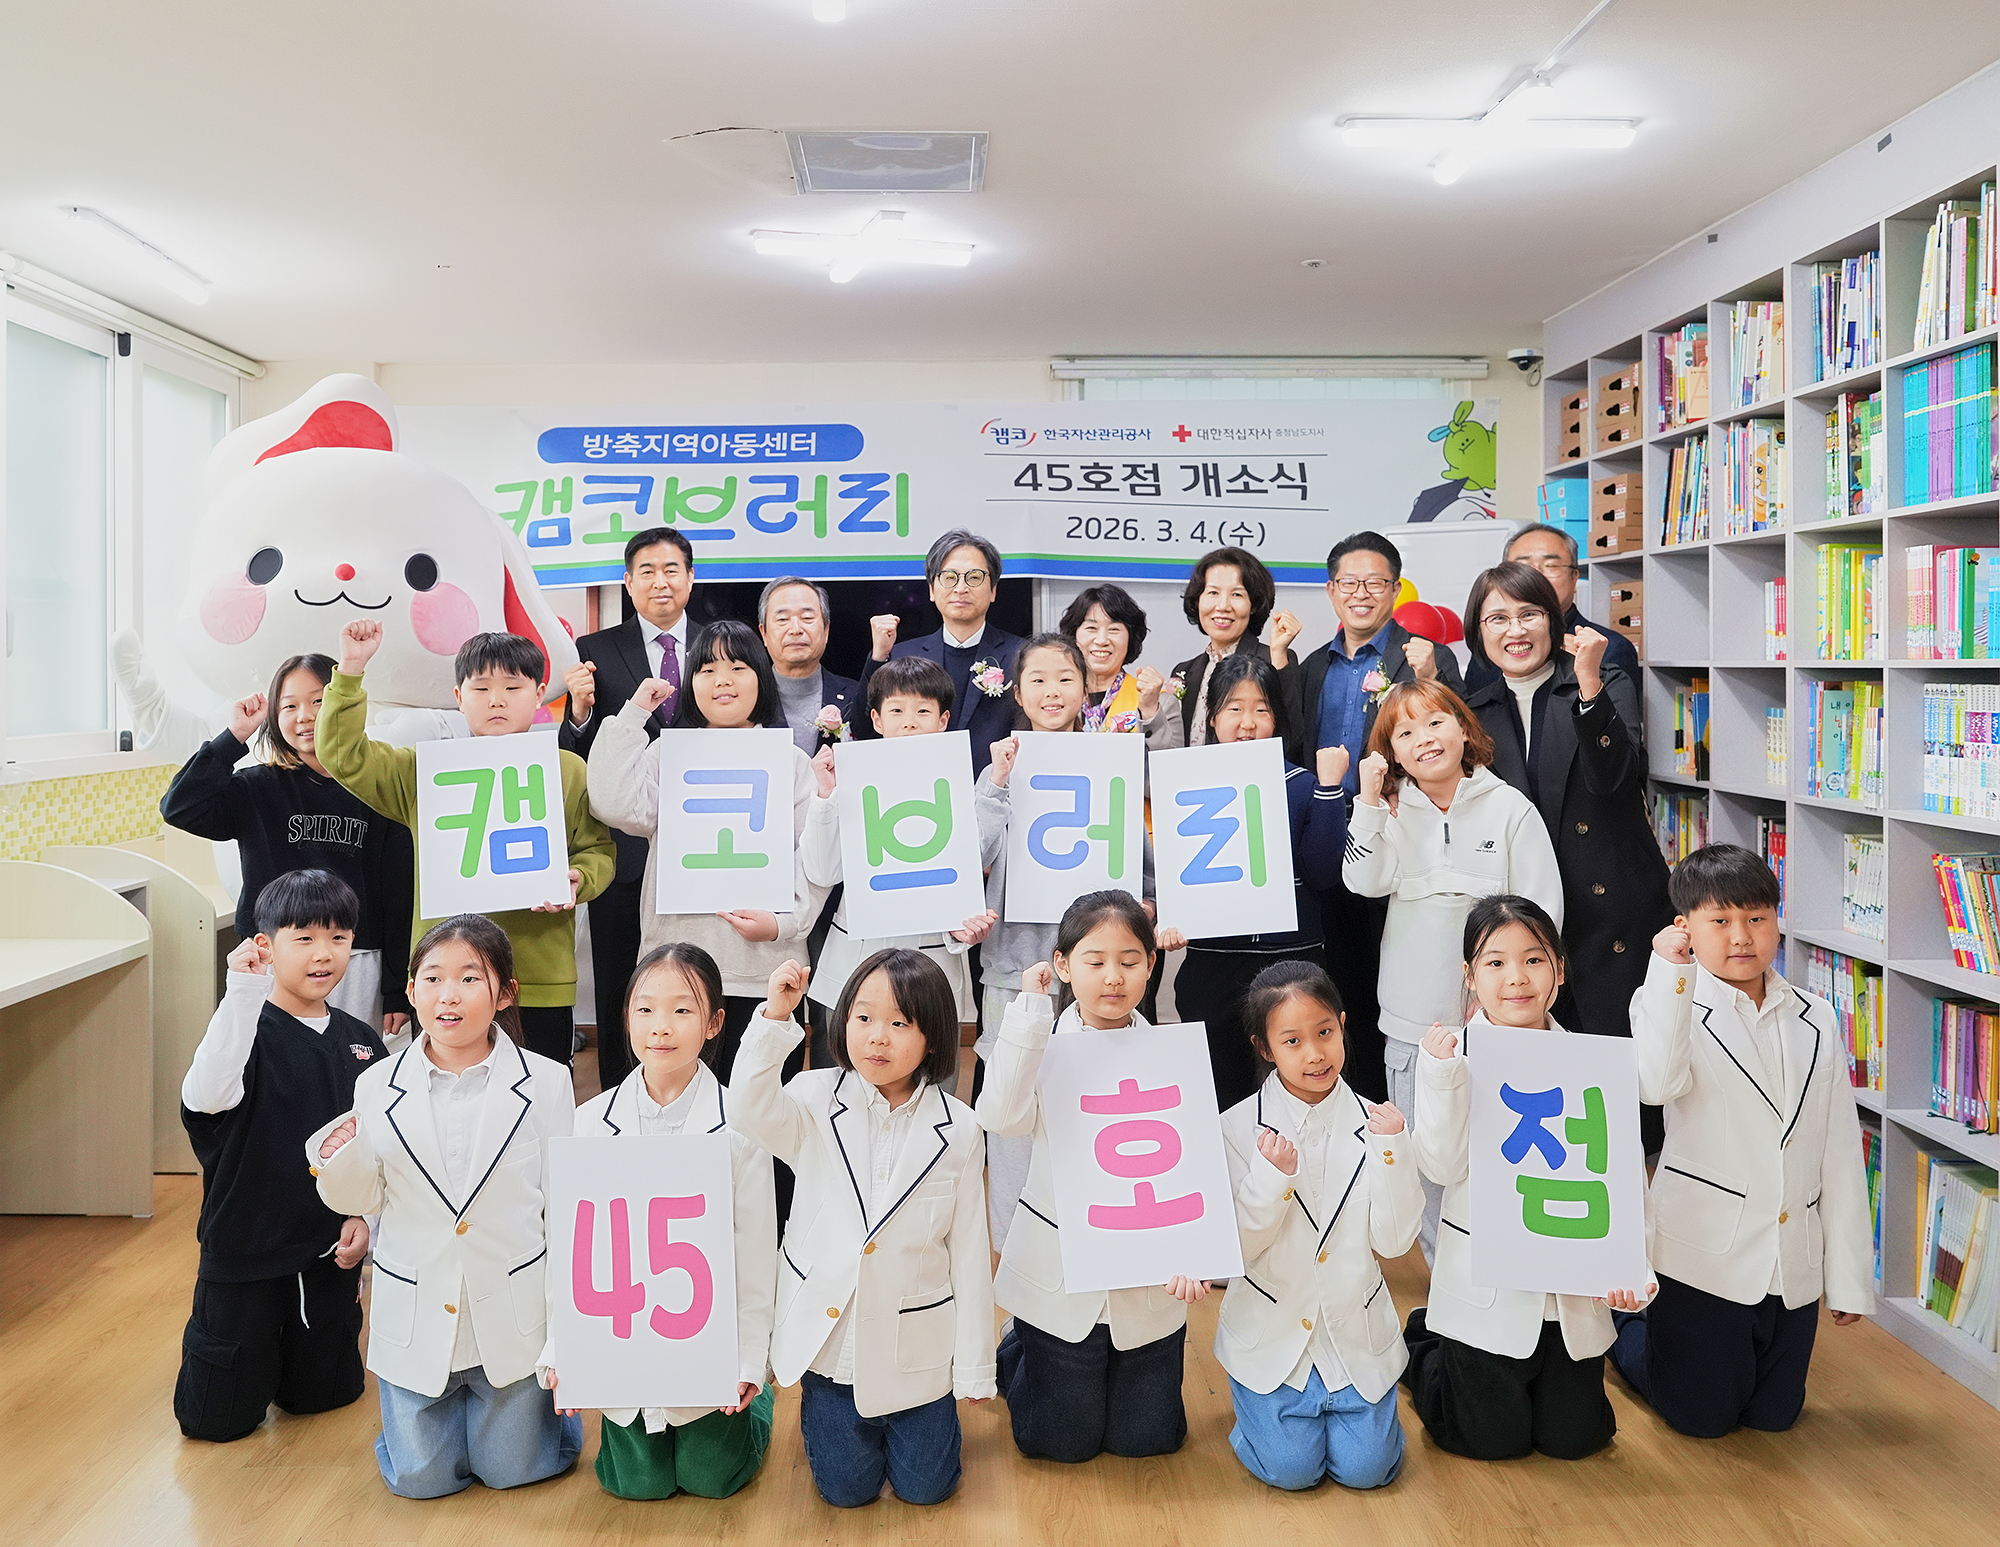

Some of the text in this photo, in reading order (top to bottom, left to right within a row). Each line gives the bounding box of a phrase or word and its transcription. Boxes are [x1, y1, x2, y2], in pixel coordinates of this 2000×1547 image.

[582, 432, 818, 458] 방축지역아동센터
[989, 427, 1152, 446] 캠코 한국자산관리공사
[1013, 462, 1308, 501] 45호점 개소식
[1196, 428, 1325, 441] 대한적십자사 충청남도지사
[494, 472, 910, 548] 캠코브러리
[1065, 516, 1266, 548] 2026. 3. 4.(수)
[288, 814, 369, 849] SPIRIT
[433, 763, 550, 878] 캠
[682, 769, 769, 869] 코
[862, 778, 958, 891] 브
[1027, 774, 1126, 880] 러
[1175, 783, 1268, 887] 리
[1080, 1078, 1204, 1230] 호
[1500, 1081, 1610, 1239] 점
[571, 1193, 714, 1340] 45
